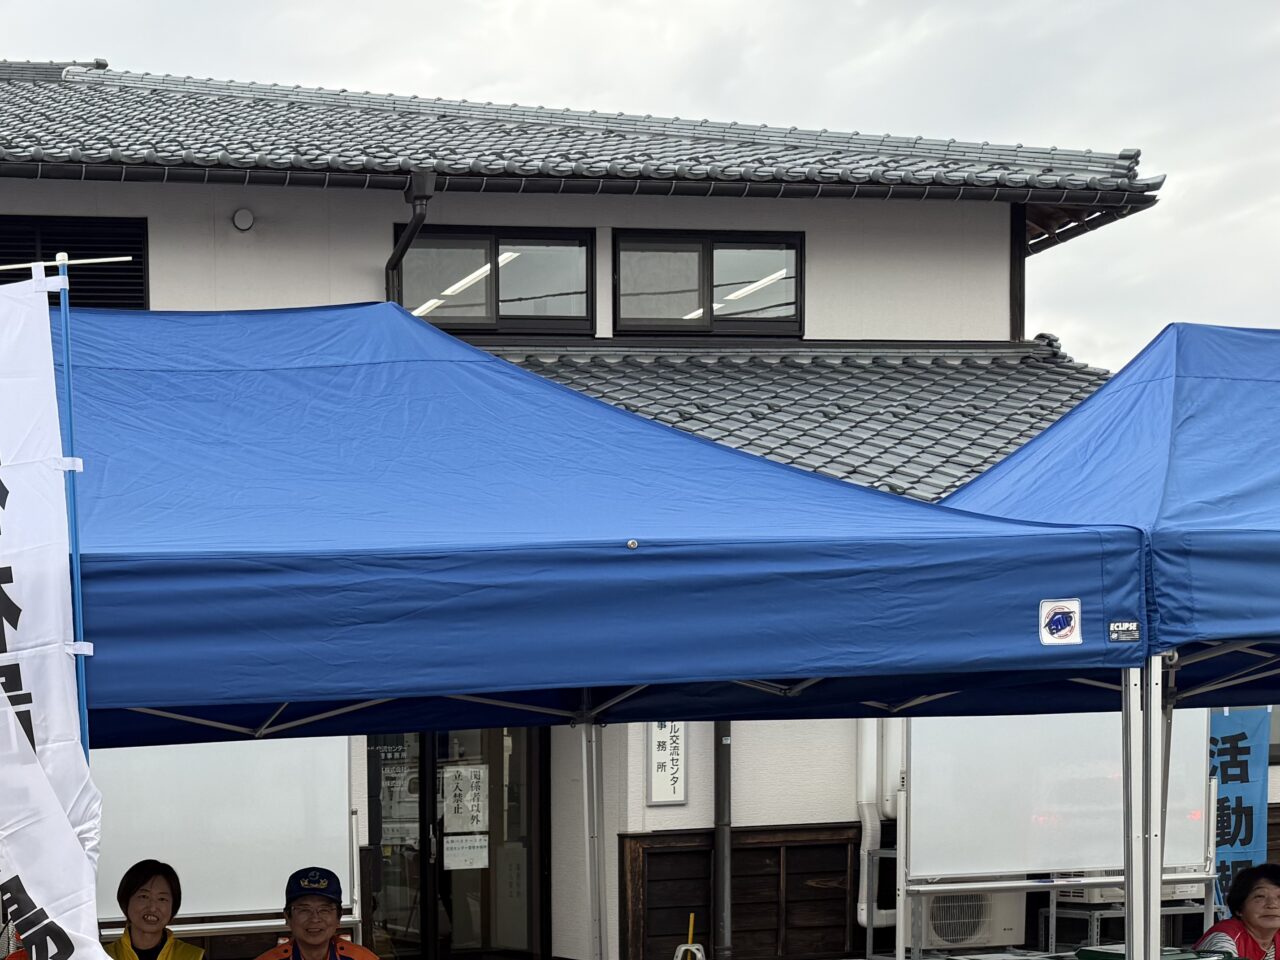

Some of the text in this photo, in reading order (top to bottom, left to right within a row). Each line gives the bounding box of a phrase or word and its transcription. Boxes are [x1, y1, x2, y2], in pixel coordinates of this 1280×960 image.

[1109, 622, 1137, 631] ECLIPSE
[453, 770, 462, 814] 立入禁止
[470, 770, 480, 825] 関係者以外
